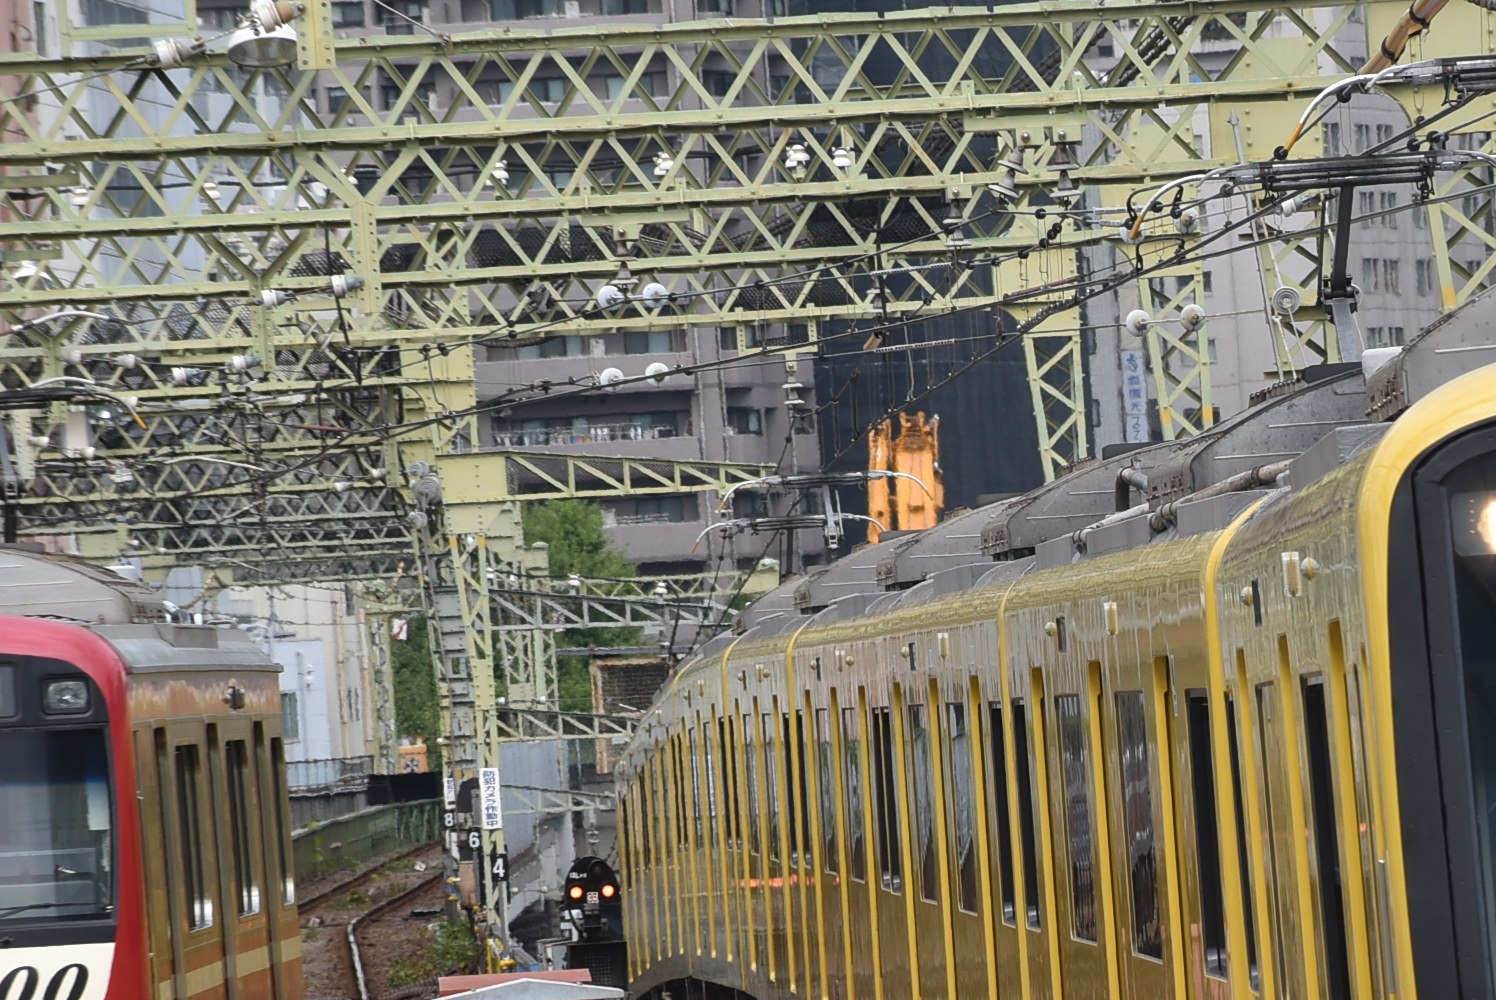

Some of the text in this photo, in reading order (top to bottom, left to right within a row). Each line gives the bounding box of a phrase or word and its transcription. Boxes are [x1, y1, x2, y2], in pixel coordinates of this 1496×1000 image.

[482, 770, 499, 828] 防犯カメラ作動中
[444, 812, 454, 827] 8
[469, 831, 480, 848] 6
[492, 858, 505, 878] 4
